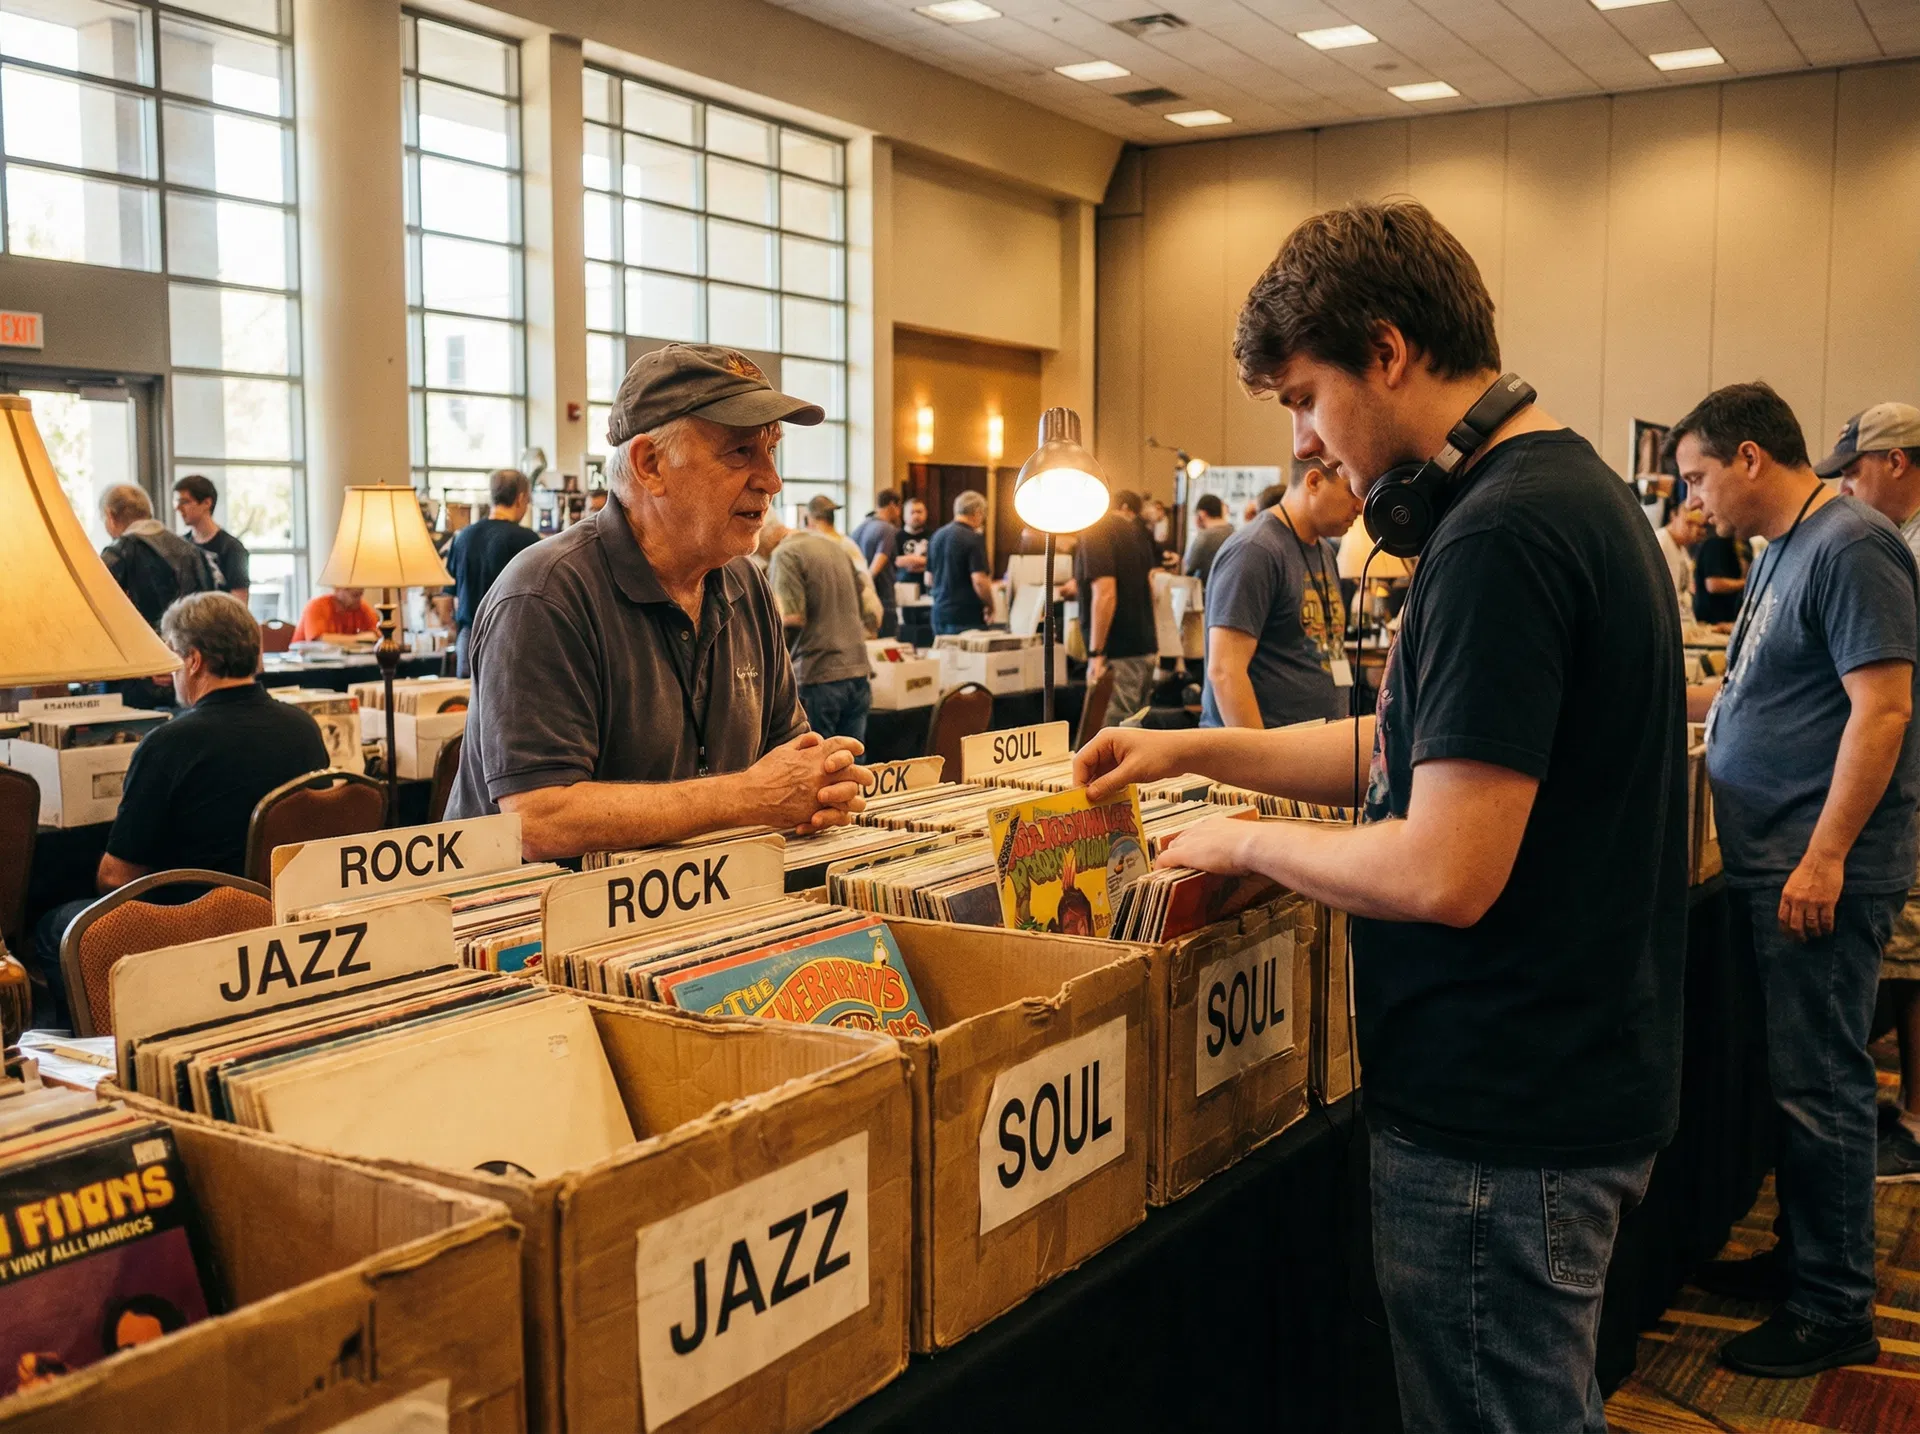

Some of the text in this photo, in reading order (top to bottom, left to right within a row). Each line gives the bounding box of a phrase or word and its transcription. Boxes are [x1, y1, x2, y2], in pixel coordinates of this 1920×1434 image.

[1, 312, 37, 345] EXIT
[857, 765, 911, 798] OCK
[993, 731, 1042, 764] SOUL
[340, 830, 464, 889] ROCK
[608, 854, 731, 928] ROCK
[219, 922, 371, 1002] JAZZ
[1206, 957, 1284, 1058] SOUL
[997, 1060, 1112, 1188] SOUL
[670, 1189, 850, 1356] JAZZ
